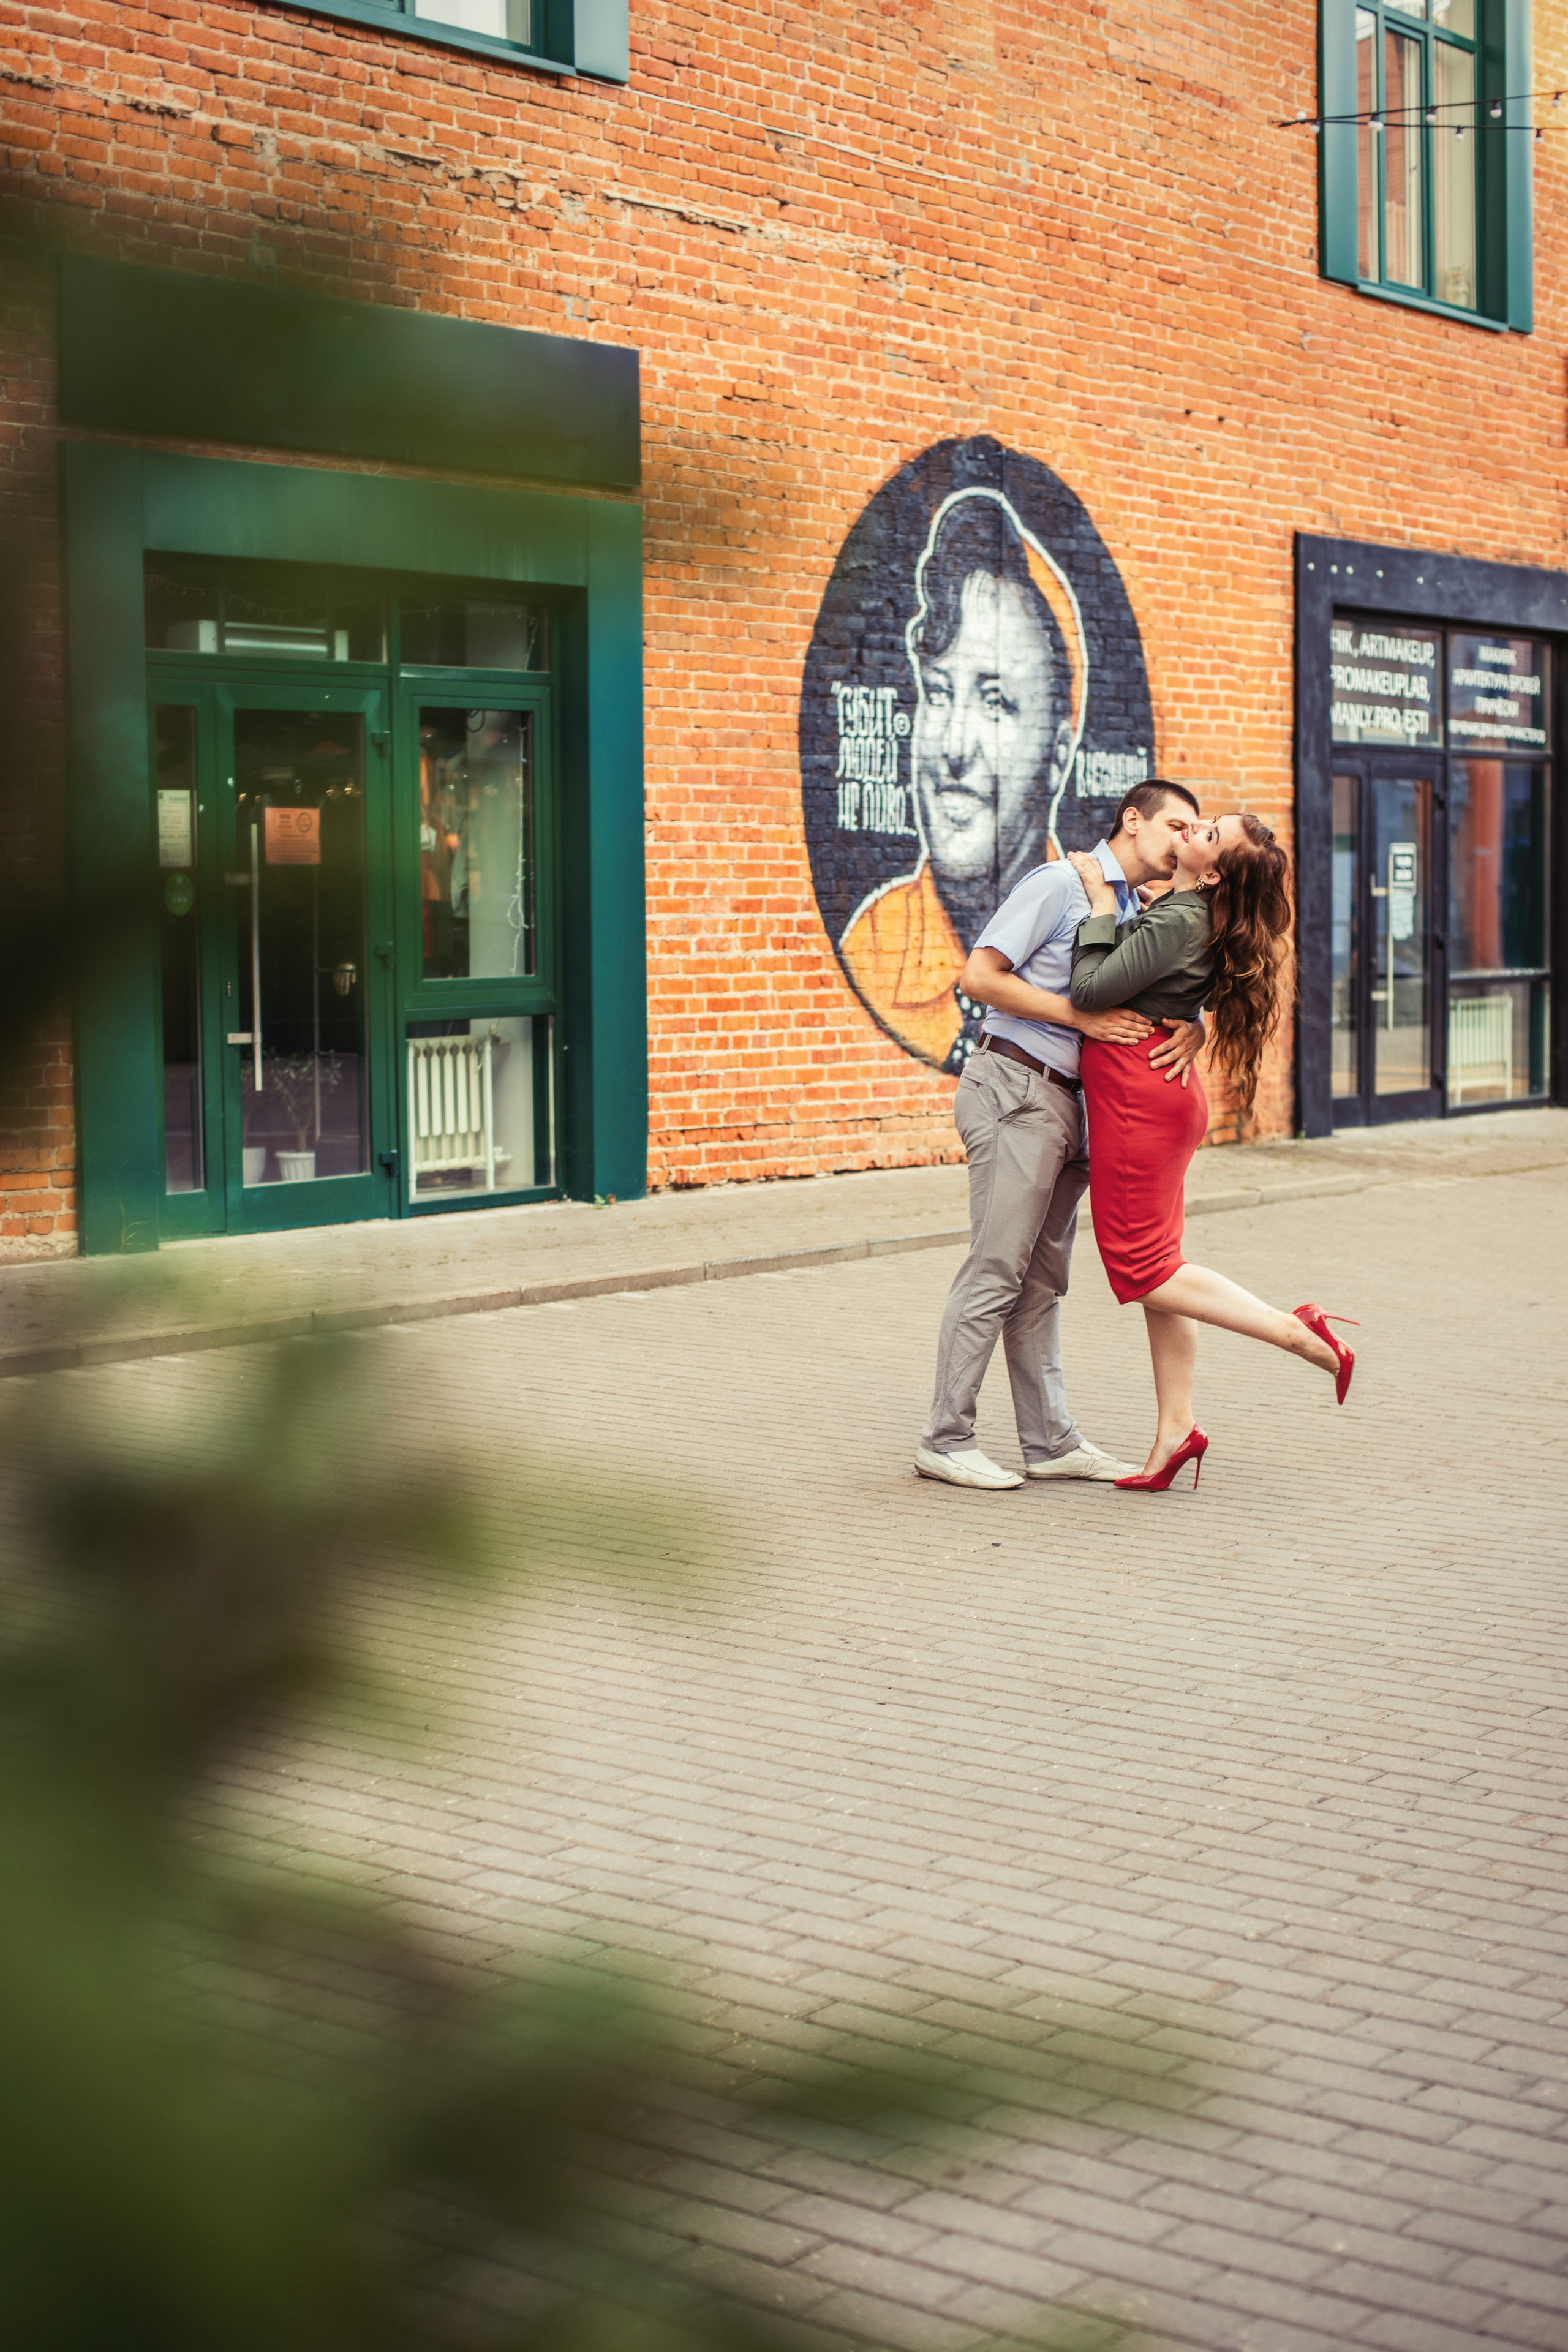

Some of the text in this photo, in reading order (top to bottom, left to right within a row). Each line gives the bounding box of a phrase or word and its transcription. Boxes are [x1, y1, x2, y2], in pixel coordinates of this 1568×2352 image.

[1359, 633, 1435, 669] ARTMAKEUP,
[835, 733, 898, 784] ЛЮДЕЙ
[837, 782, 860, 831] НЕ
